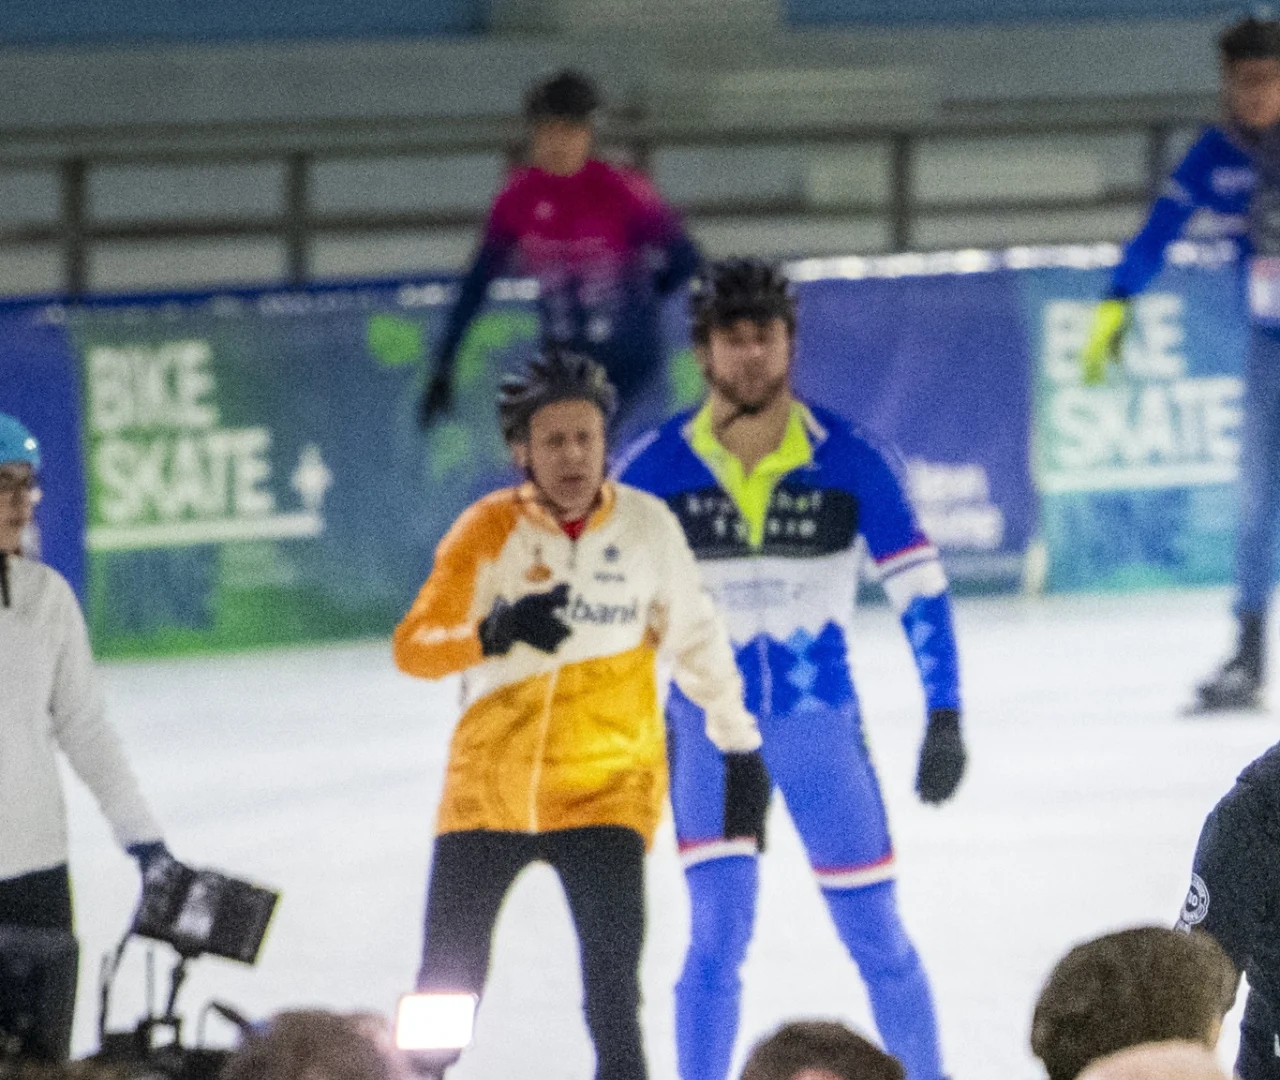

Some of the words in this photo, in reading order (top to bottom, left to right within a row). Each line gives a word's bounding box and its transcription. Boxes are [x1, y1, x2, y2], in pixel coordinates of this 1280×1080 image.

[1046, 294, 1184, 384] BE
[90, 340, 218, 430] BIKE
[1052, 375, 1243, 467] SKATE
[97, 427, 275, 523] SKATE
